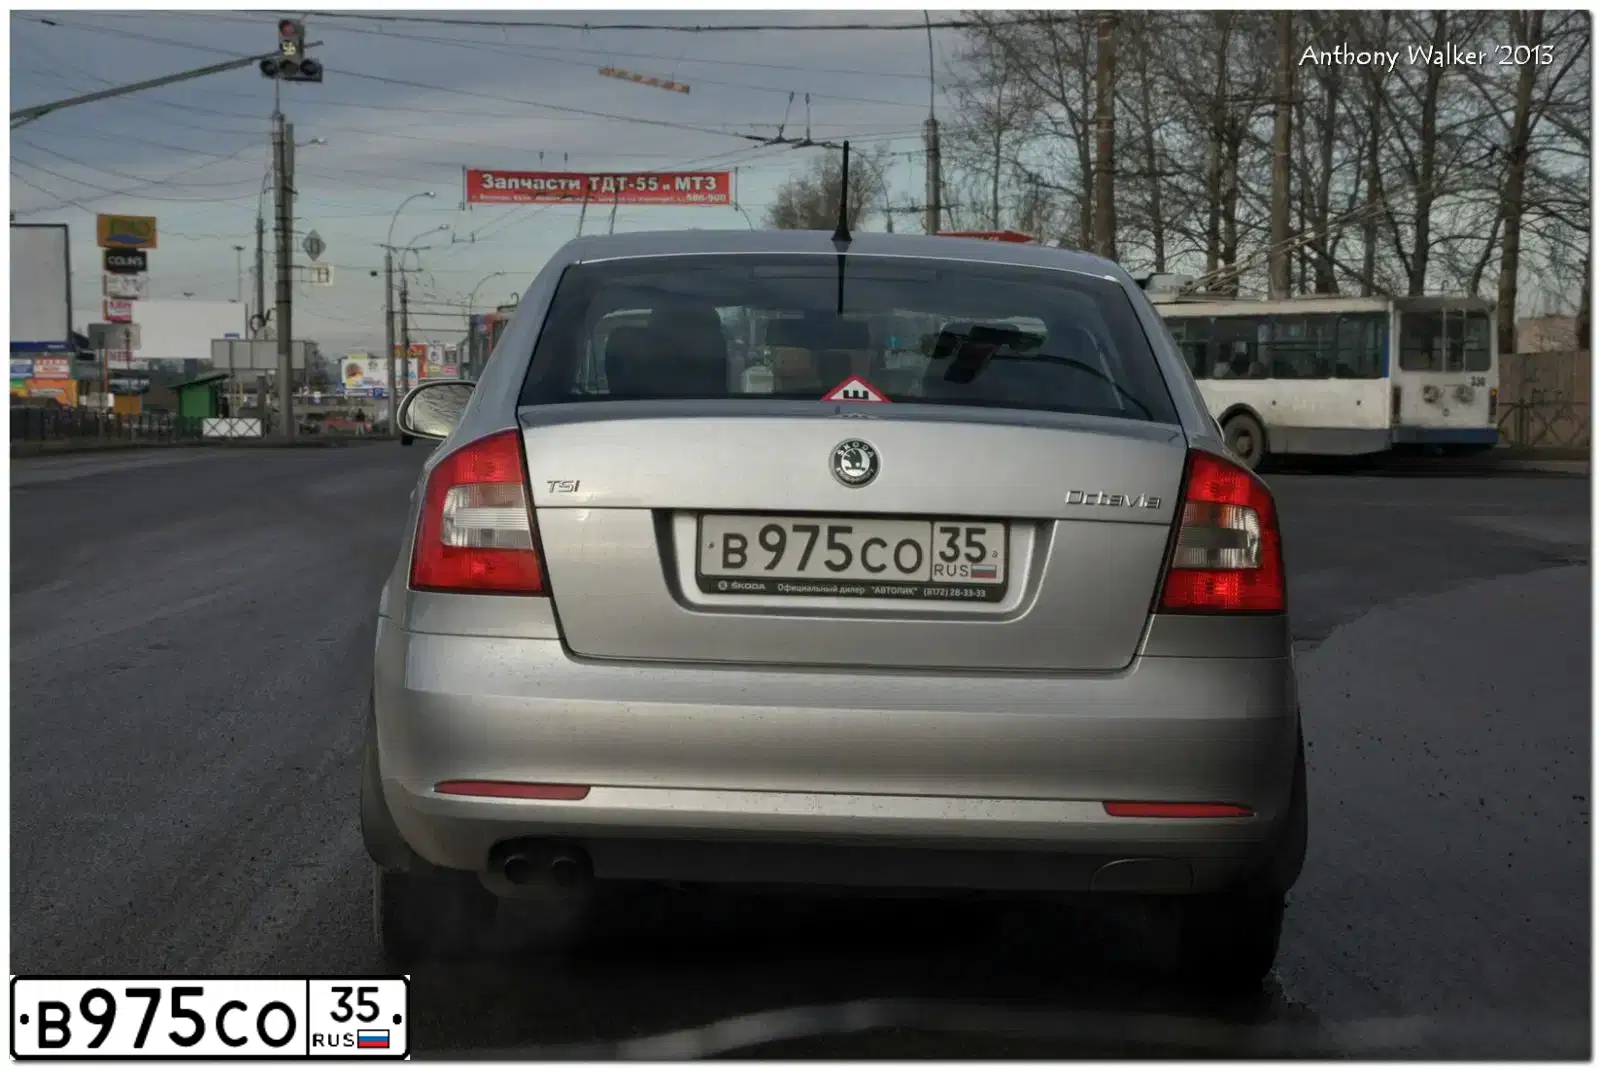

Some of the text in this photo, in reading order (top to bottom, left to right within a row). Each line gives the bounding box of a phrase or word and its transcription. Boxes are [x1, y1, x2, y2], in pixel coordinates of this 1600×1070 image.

[481, 172, 581, 190] Запчасти
[588, 175, 659, 194] ТДТ-55
[674, 175, 717, 191] МТЗ
[546, 479, 580, 493] TSI
[1065, 490, 1161, 509] Octavia
[722, 523, 987, 574] В975СО 35
[933, 563, 969, 578] RUS
[777, 583, 838, 594] Официальный
[839, 585, 866, 596] дилер
